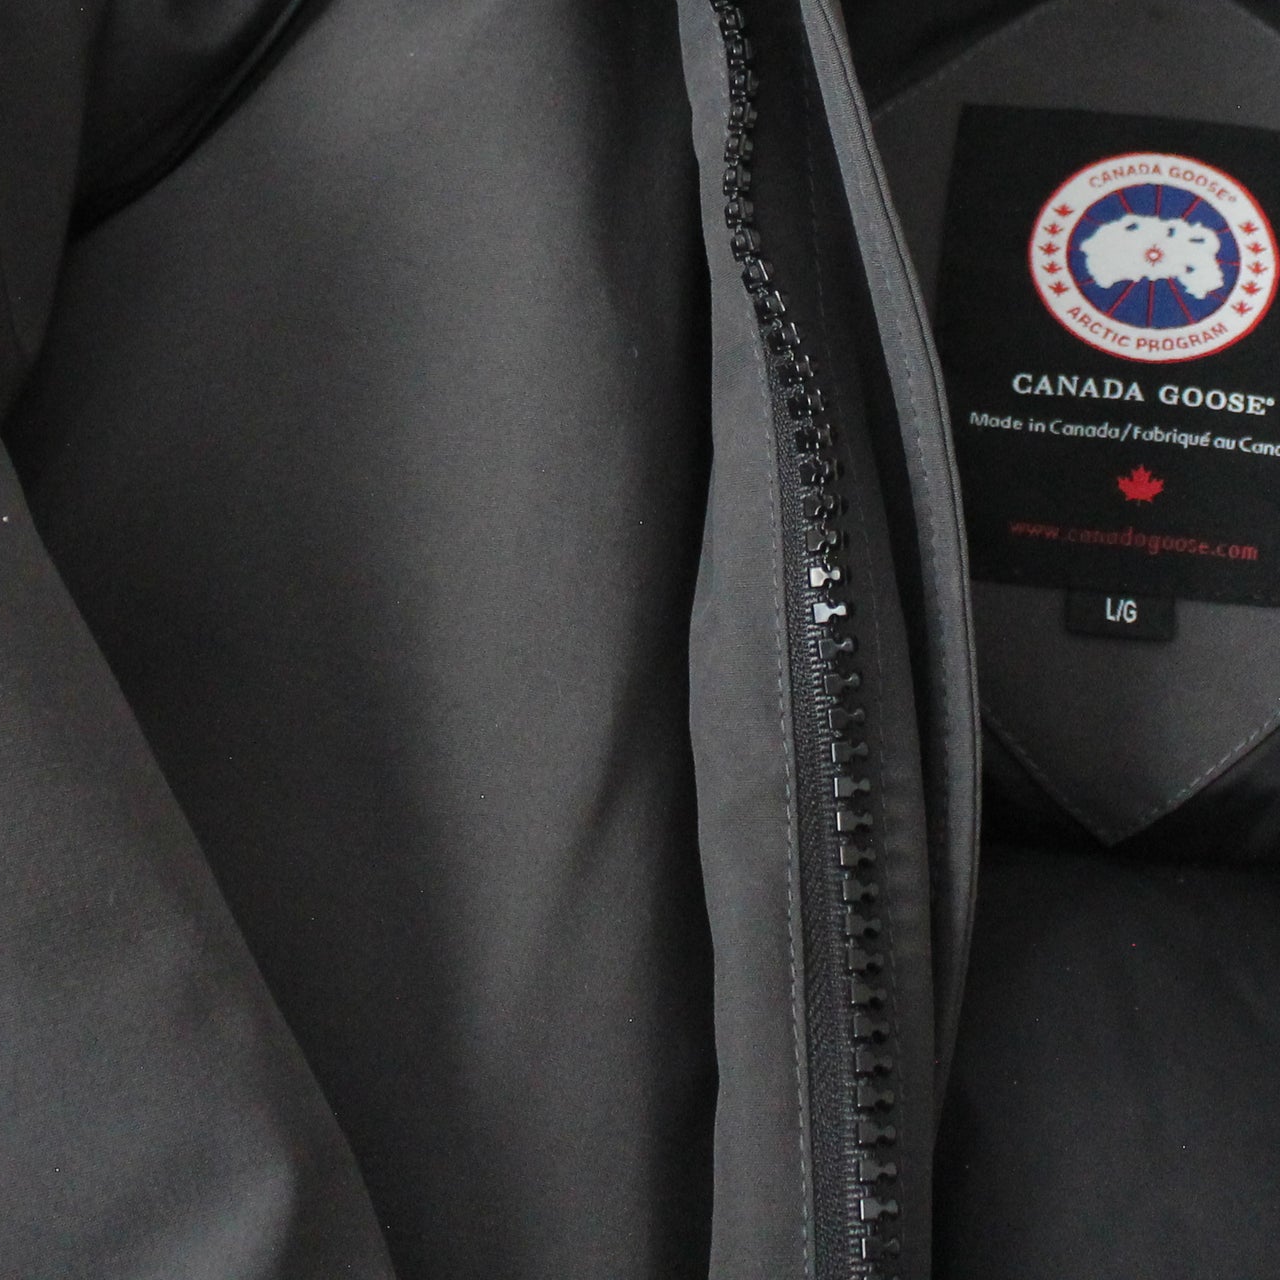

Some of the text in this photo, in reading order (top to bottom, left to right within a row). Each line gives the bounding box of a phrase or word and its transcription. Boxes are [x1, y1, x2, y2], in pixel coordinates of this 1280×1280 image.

[1088, 163, 1162, 189] CANADA
[1066, 306, 1229, 353] ARCTIC PROGRAM
[1012, 373, 1145, 402] CANADA
[970, 412, 1023, 431] Made
[1028, 418, 1046, 434] in
[1213, 437, 1236, 452] au
[1008, 520, 1259, 561] www.canadagoose.com
[1105, 596, 1138, 624] L/G
